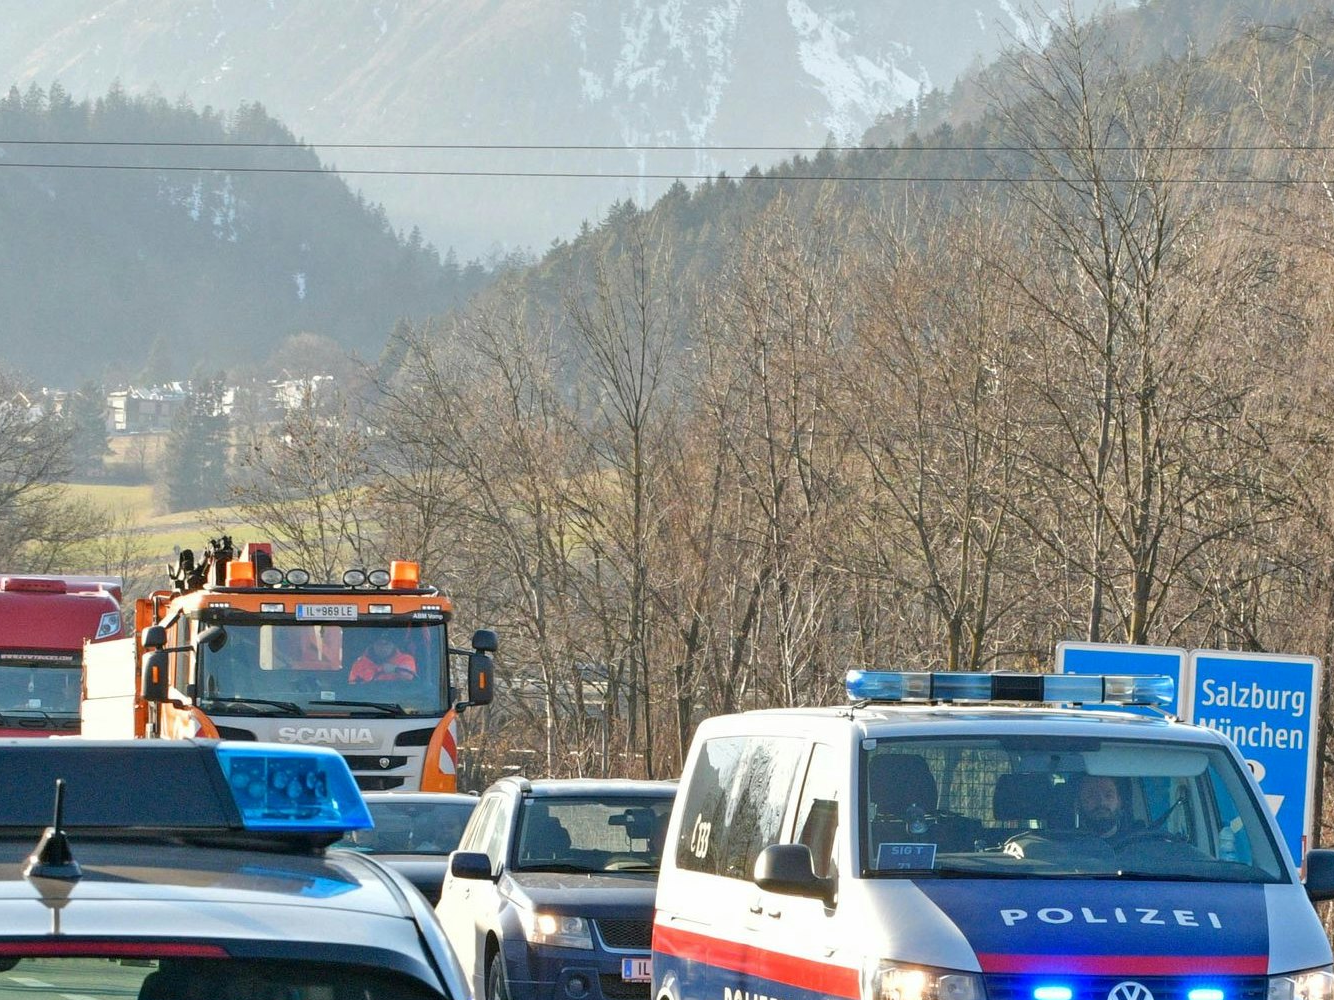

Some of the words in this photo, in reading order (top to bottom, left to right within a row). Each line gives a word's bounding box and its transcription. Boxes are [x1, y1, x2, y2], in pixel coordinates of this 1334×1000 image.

[1201, 679, 1305, 717] Salzburg
[278, 727, 374, 744] SCANIA
[1199, 717, 1304, 750] München
[1000, 907, 1222, 929] POLIZEI
